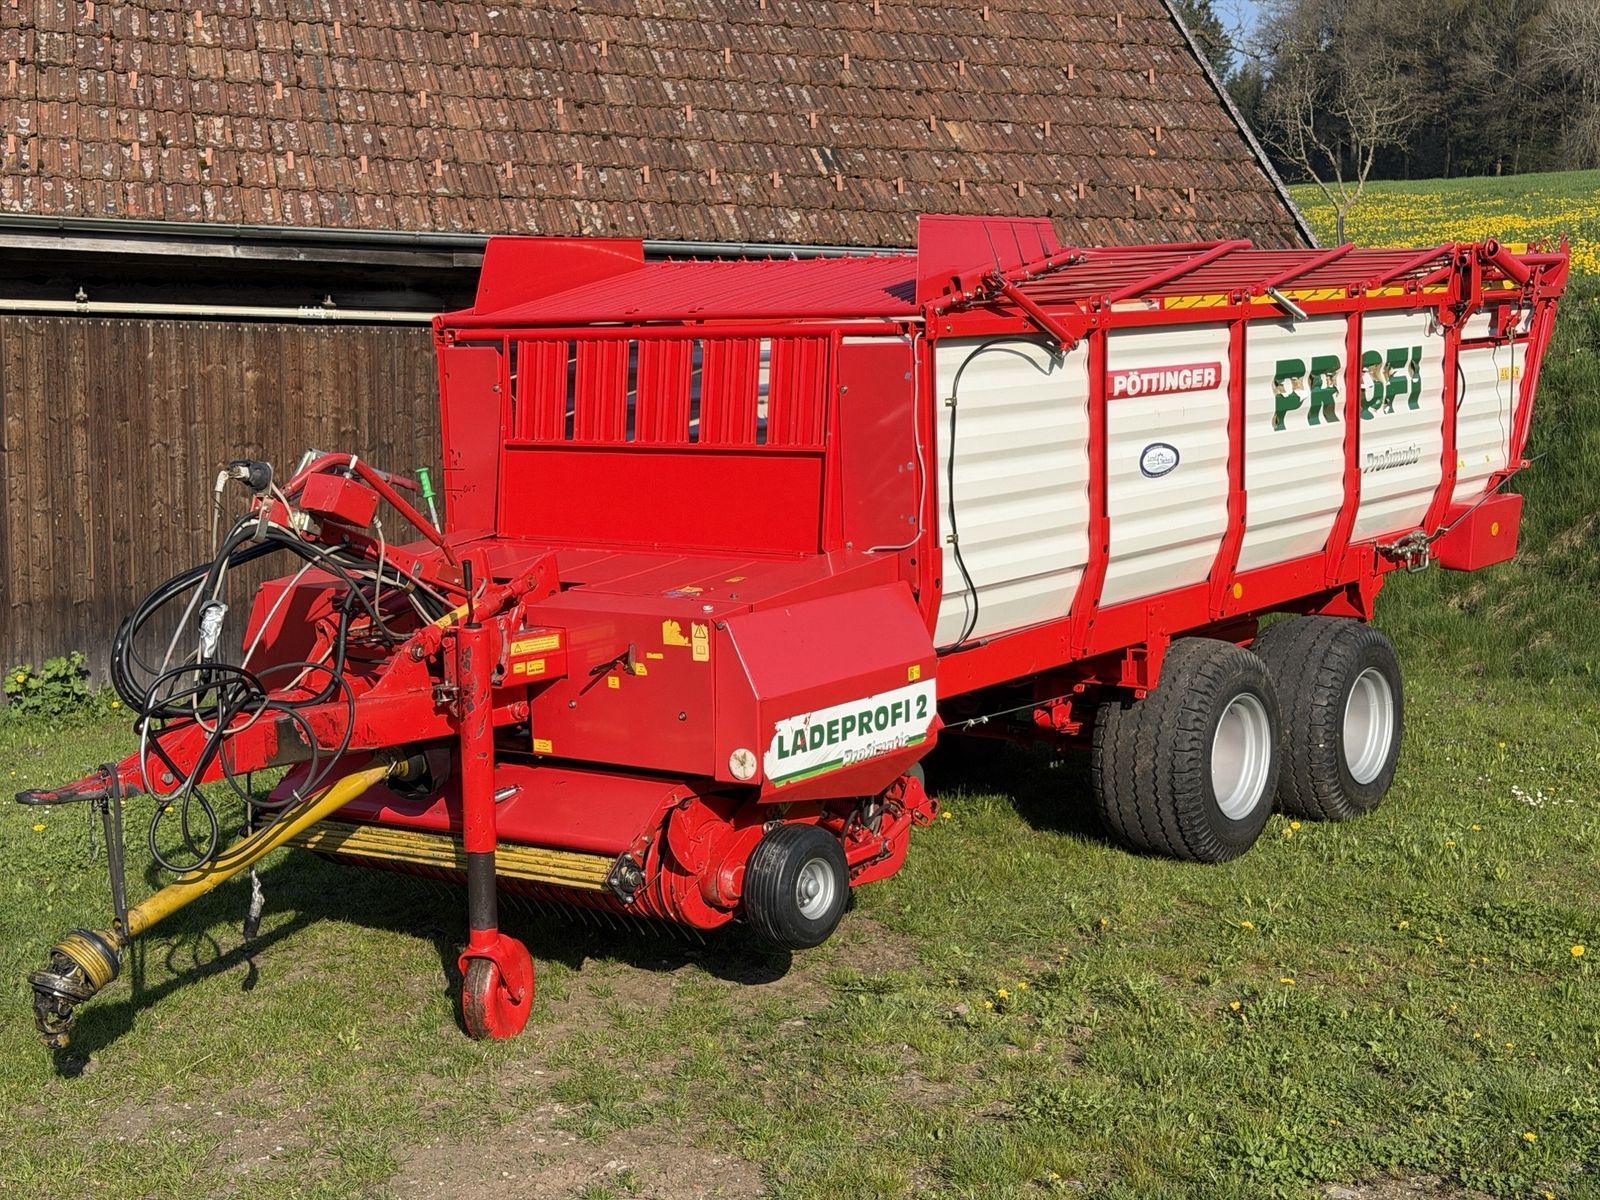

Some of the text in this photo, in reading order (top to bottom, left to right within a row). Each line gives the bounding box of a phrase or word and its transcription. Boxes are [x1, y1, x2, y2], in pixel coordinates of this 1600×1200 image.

[1113, 367, 1216, 396] PÖTTINGER
[1272, 346, 1422, 432] PROFI
[1364, 443, 1421, 473] Profimatic
[778, 694, 928, 760] LADEPROFI 2
